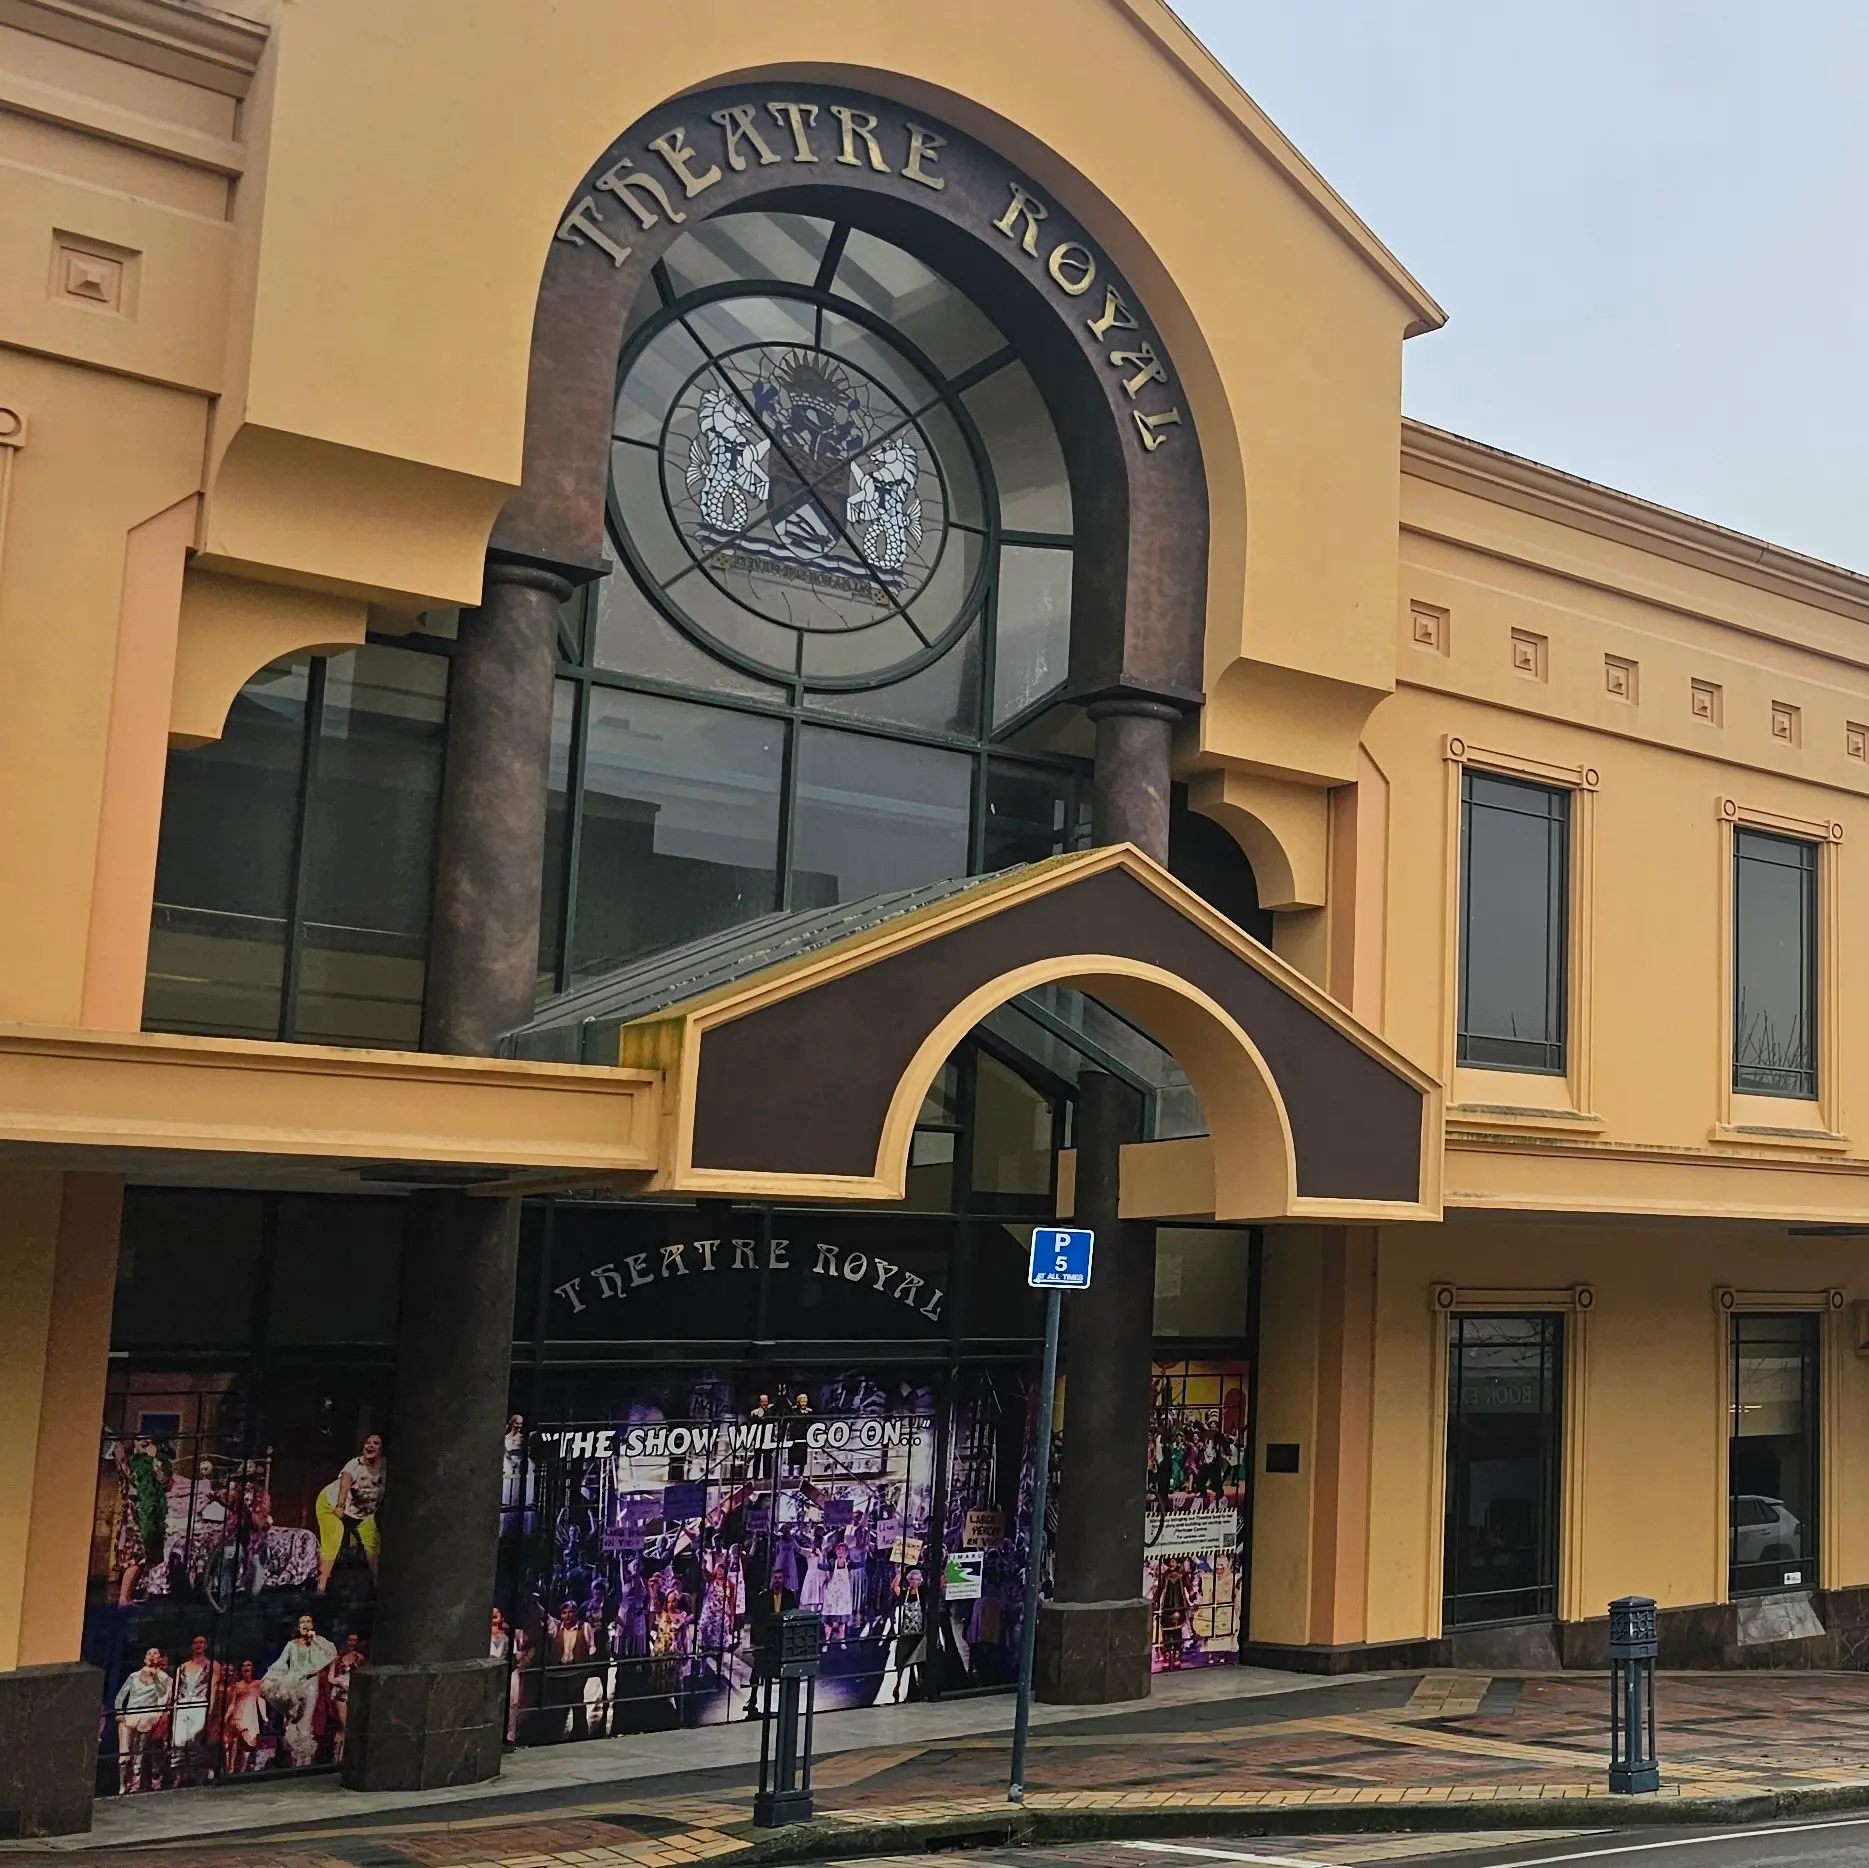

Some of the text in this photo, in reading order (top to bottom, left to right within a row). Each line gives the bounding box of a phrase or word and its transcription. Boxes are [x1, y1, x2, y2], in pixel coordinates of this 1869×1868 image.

[556, 102, 1183, 451] THEATRE ROYAL
[1054, 1233, 1072, 1253] P
[1047, 1272, 1061, 1280] ALL
[1062, 1273, 1084, 1281] TIMES
[1054, 1255, 1068, 1272] 5
[553, 1239, 944, 1322] THEATRE ROYAL
[624, 1427, 719, 1457] SHOW
[728, 1422, 794, 1450] WILL
[806, 1422, 850, 1448] GO
